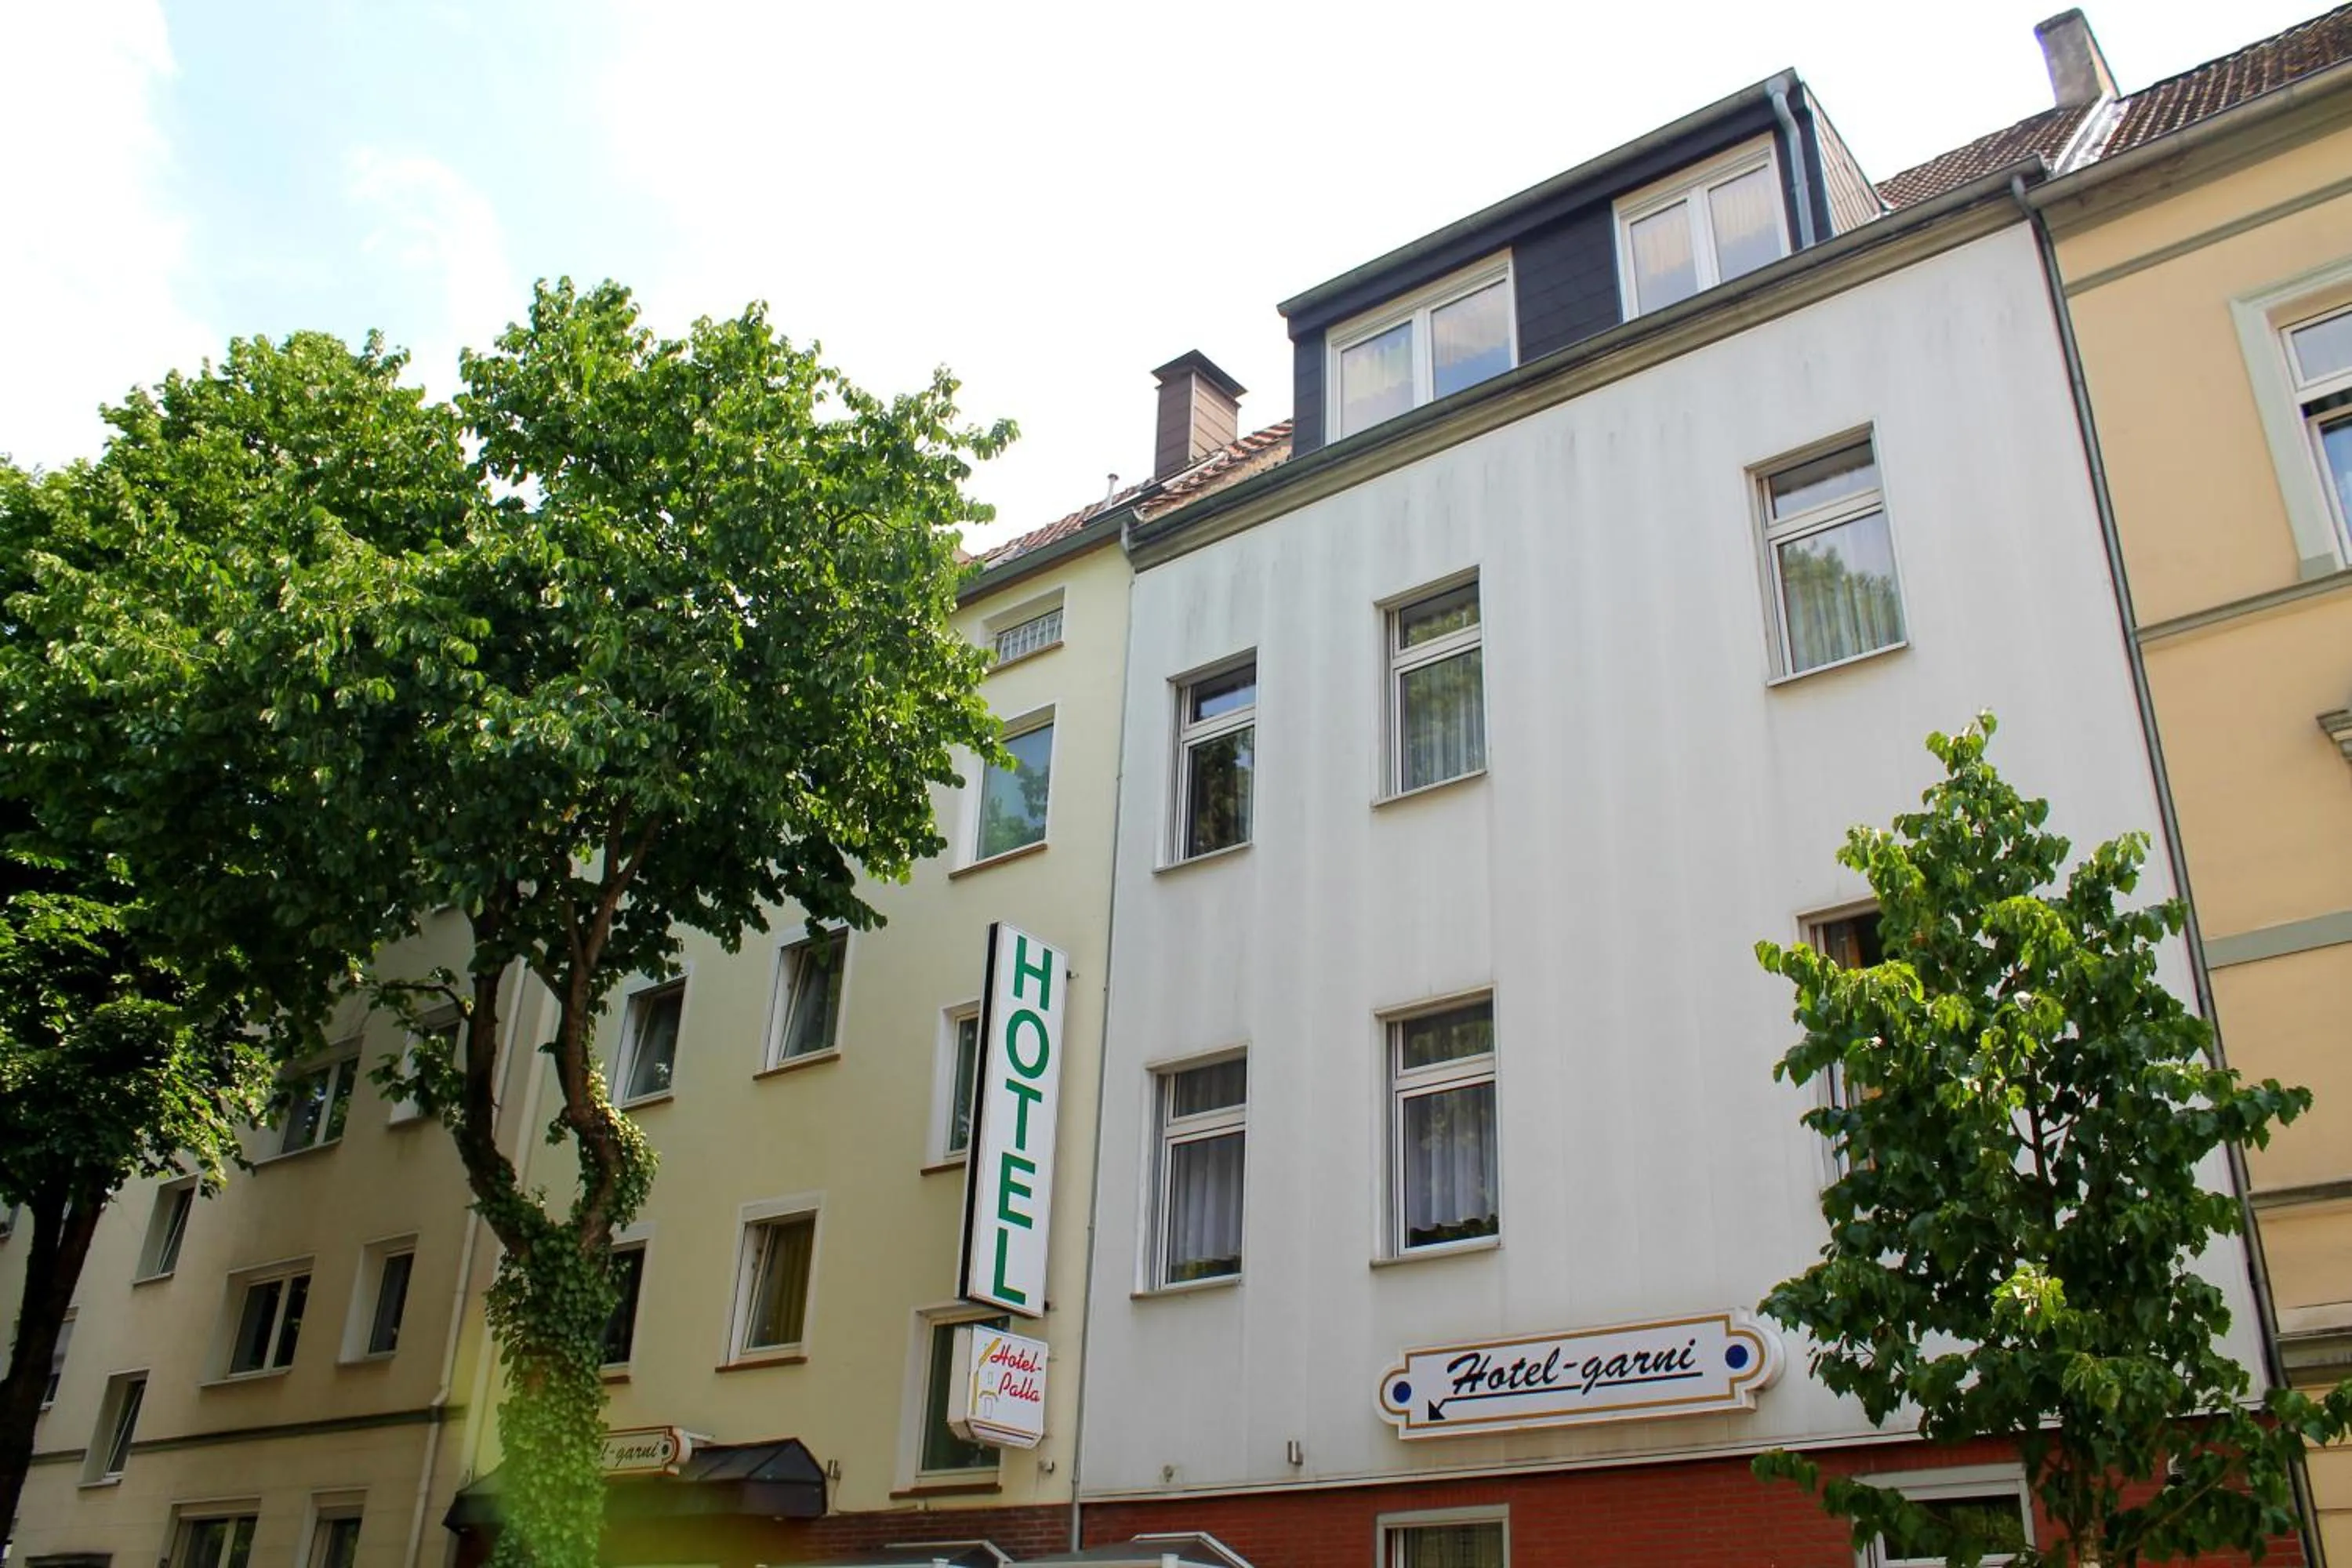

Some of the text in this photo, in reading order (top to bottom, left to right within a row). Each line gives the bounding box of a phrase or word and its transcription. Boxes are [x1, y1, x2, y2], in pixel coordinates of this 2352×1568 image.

[993, 935, 1053, 1305] HOTEL
[999, 1371, 1041, 1403] Palla
[1447, 1338, 1697, 1395] Hotel-garni
[598, 1441, 660, 1468] l-garni
